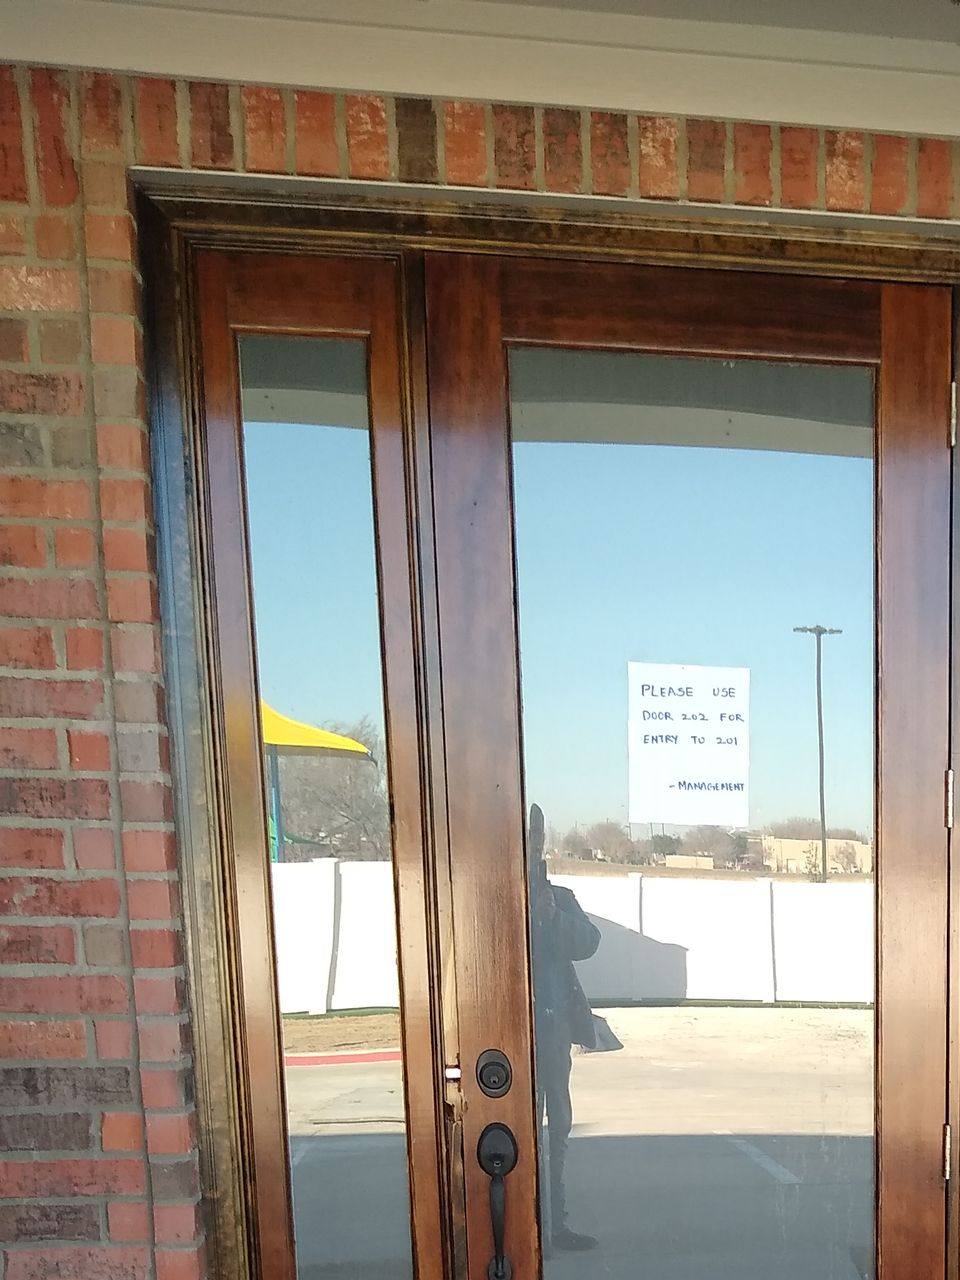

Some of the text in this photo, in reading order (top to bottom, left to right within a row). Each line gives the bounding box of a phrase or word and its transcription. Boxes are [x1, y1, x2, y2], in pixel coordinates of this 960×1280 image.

[641, 684, 736, 698] PLEASE USE
[642, 710, 674, 721] DOOR
[720, 713, 744, 722] FOR
[643, 734, 738, 746] ENTRY TO 201
